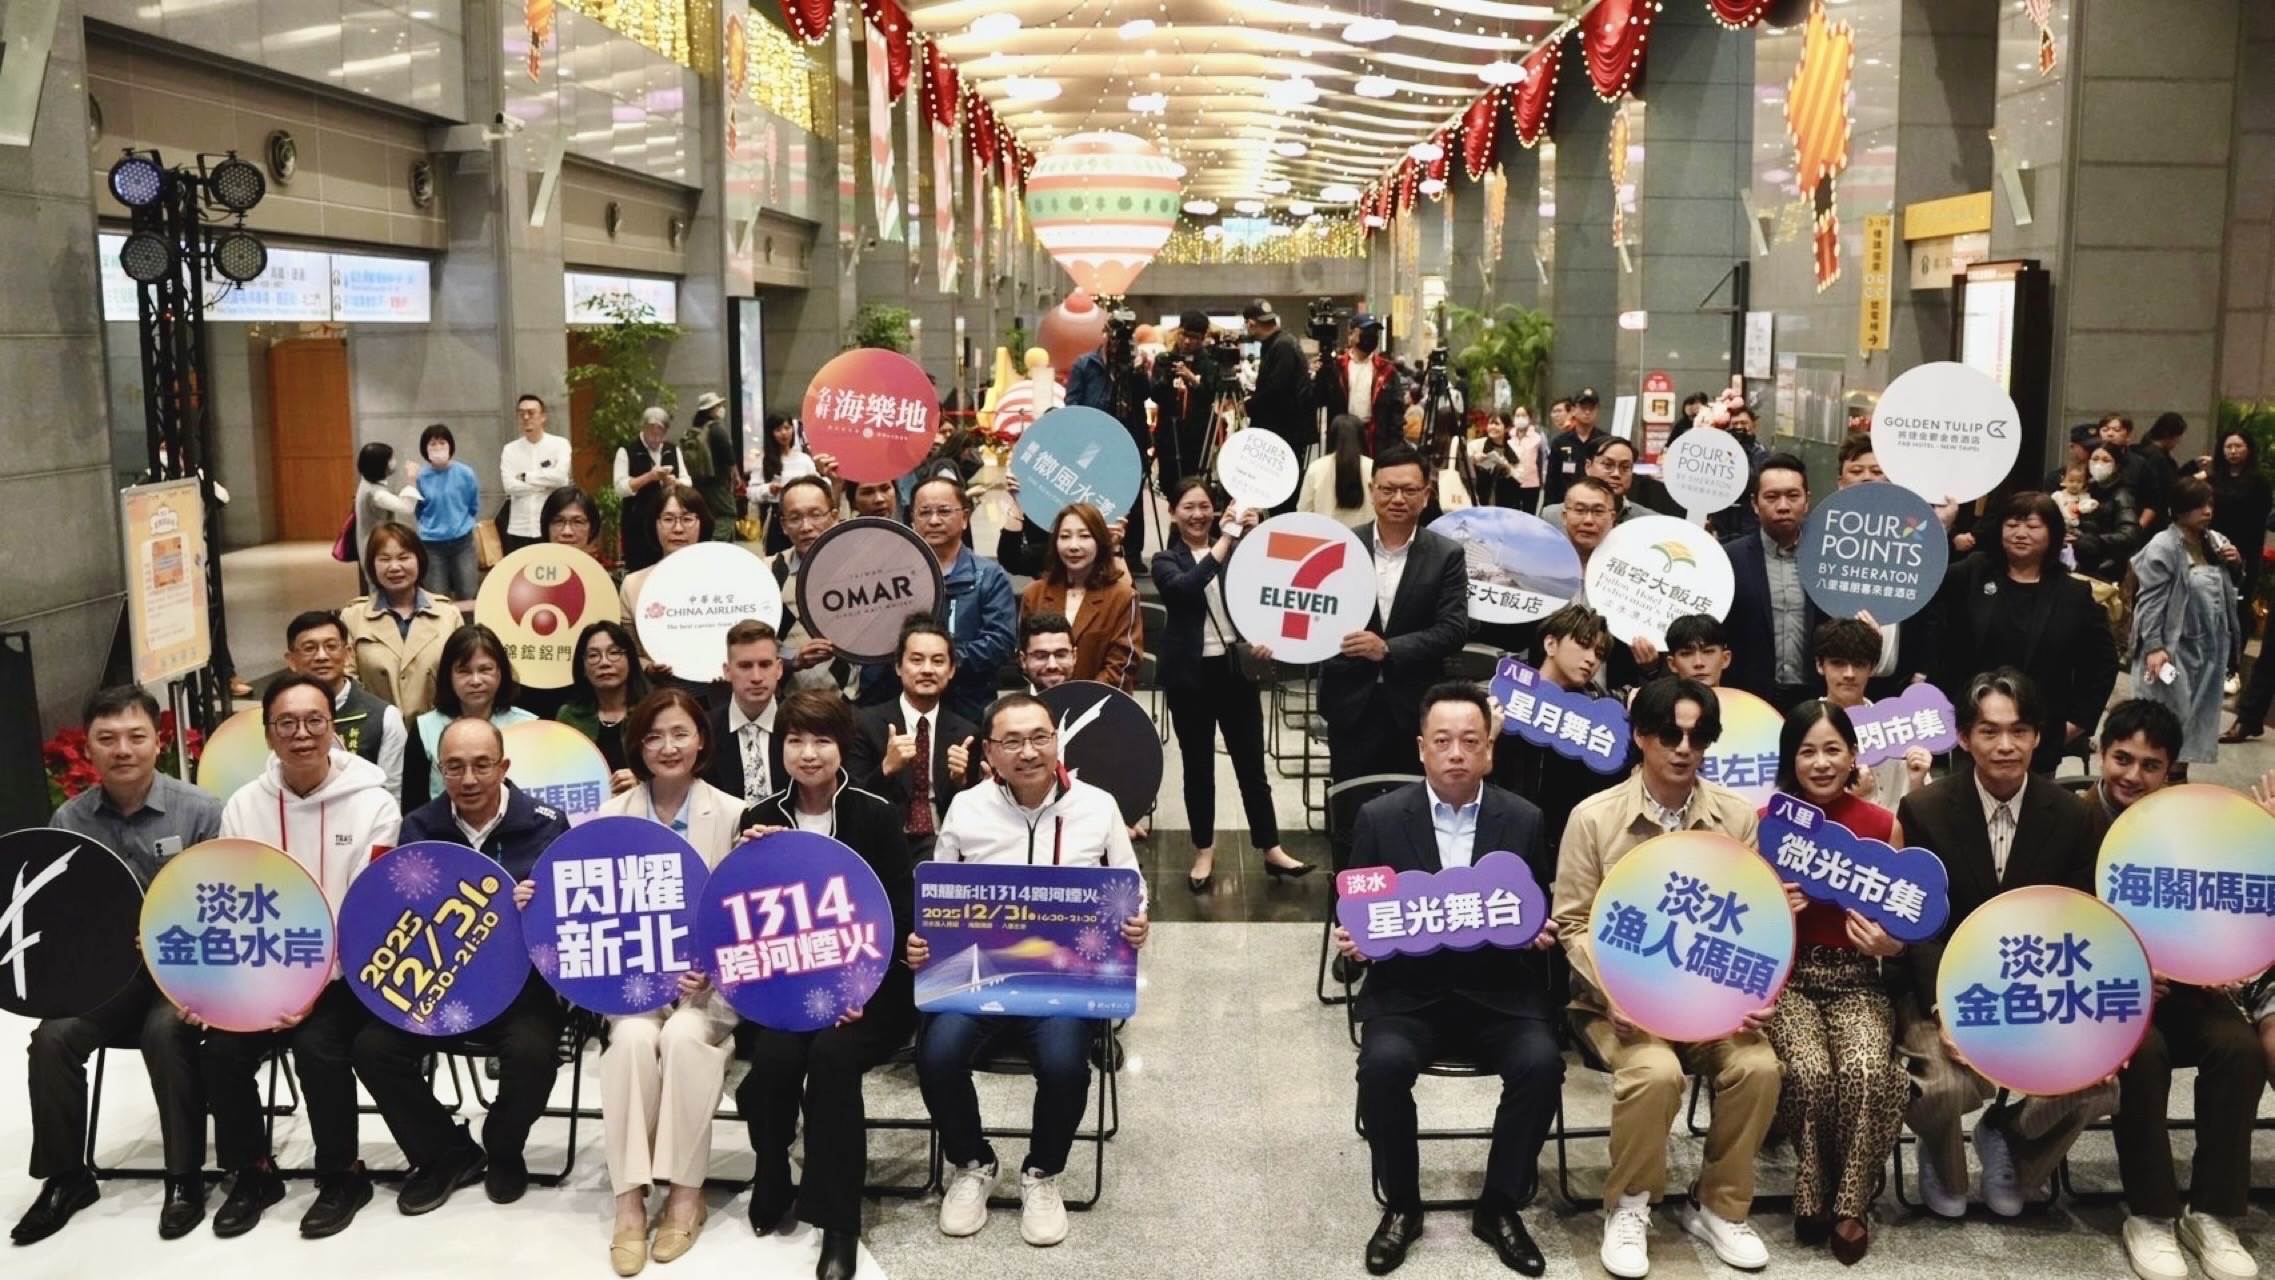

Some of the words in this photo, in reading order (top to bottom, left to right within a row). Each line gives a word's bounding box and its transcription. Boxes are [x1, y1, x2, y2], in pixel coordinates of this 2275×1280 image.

[833, 389, 928, 433] 海樂地
[1884, 416, 1940, 430] GOLDEN
[1943, 420, 1983, 433] TULIP
[1678, 456, 1735, 481] POINTS
[1681, 441, 1724, 463] FOUR
[1825, 509, 1901, 540] FOUR
[1821, 534, 1923, 567] POINTS
[535, 566, 558, 581] CH
[822, 575, 914, 612] OMAR
[1266, 531, 1347, 641] 7
[1606, 556, 1713, 614] 福容大飯店
[1818, 562, 1838, 575] BY
[1841, 564, 1919, 585] SHERATON
[667, 606, 703, 618] CHINA
[705, 603, 757, 616] AIRLINES
[689, 594, 736, 605] 中華航空
[1503, 663, 1535, 687] 八里
[1503, 688, 1617, 758] 星月舞台
[1854, 708, 1947, 755] 閃市集
[1775, 801, 1816, 830] 八里
[552, 852, 687, 918] 閃耀
[920, 882, 1099, 904] 閃耀新北1314跨河煙火
[1347, 871, 1388, 895] 淡水
[1777, 832, 1928, 924] 微光市集
[2107, 862, 2275, 919] 海關碼頭
[196, 882, 281, 924] 淡水
[721, 874, 856, 942] 1314
[921, 907, 962, 919] 2025
[1366, 887, 1523, 941] 星光舞台
[1655, 870, 1750, 936] 淡水
[155, 924, 326, 969] 金色水岸
[359, 909, 424, 990] 2025
[411, 910, 499, 1024] 16:30-21:30
[556, 913, 692, 980] 新北
[714, 922, 883, 985] 跨河煙火
[1597, 899, 1780, 1001] 漁人碼頭
[1999, 932, 2094, 980] 淡水
[1953, 977, 2144, 1028] 金色水岸
